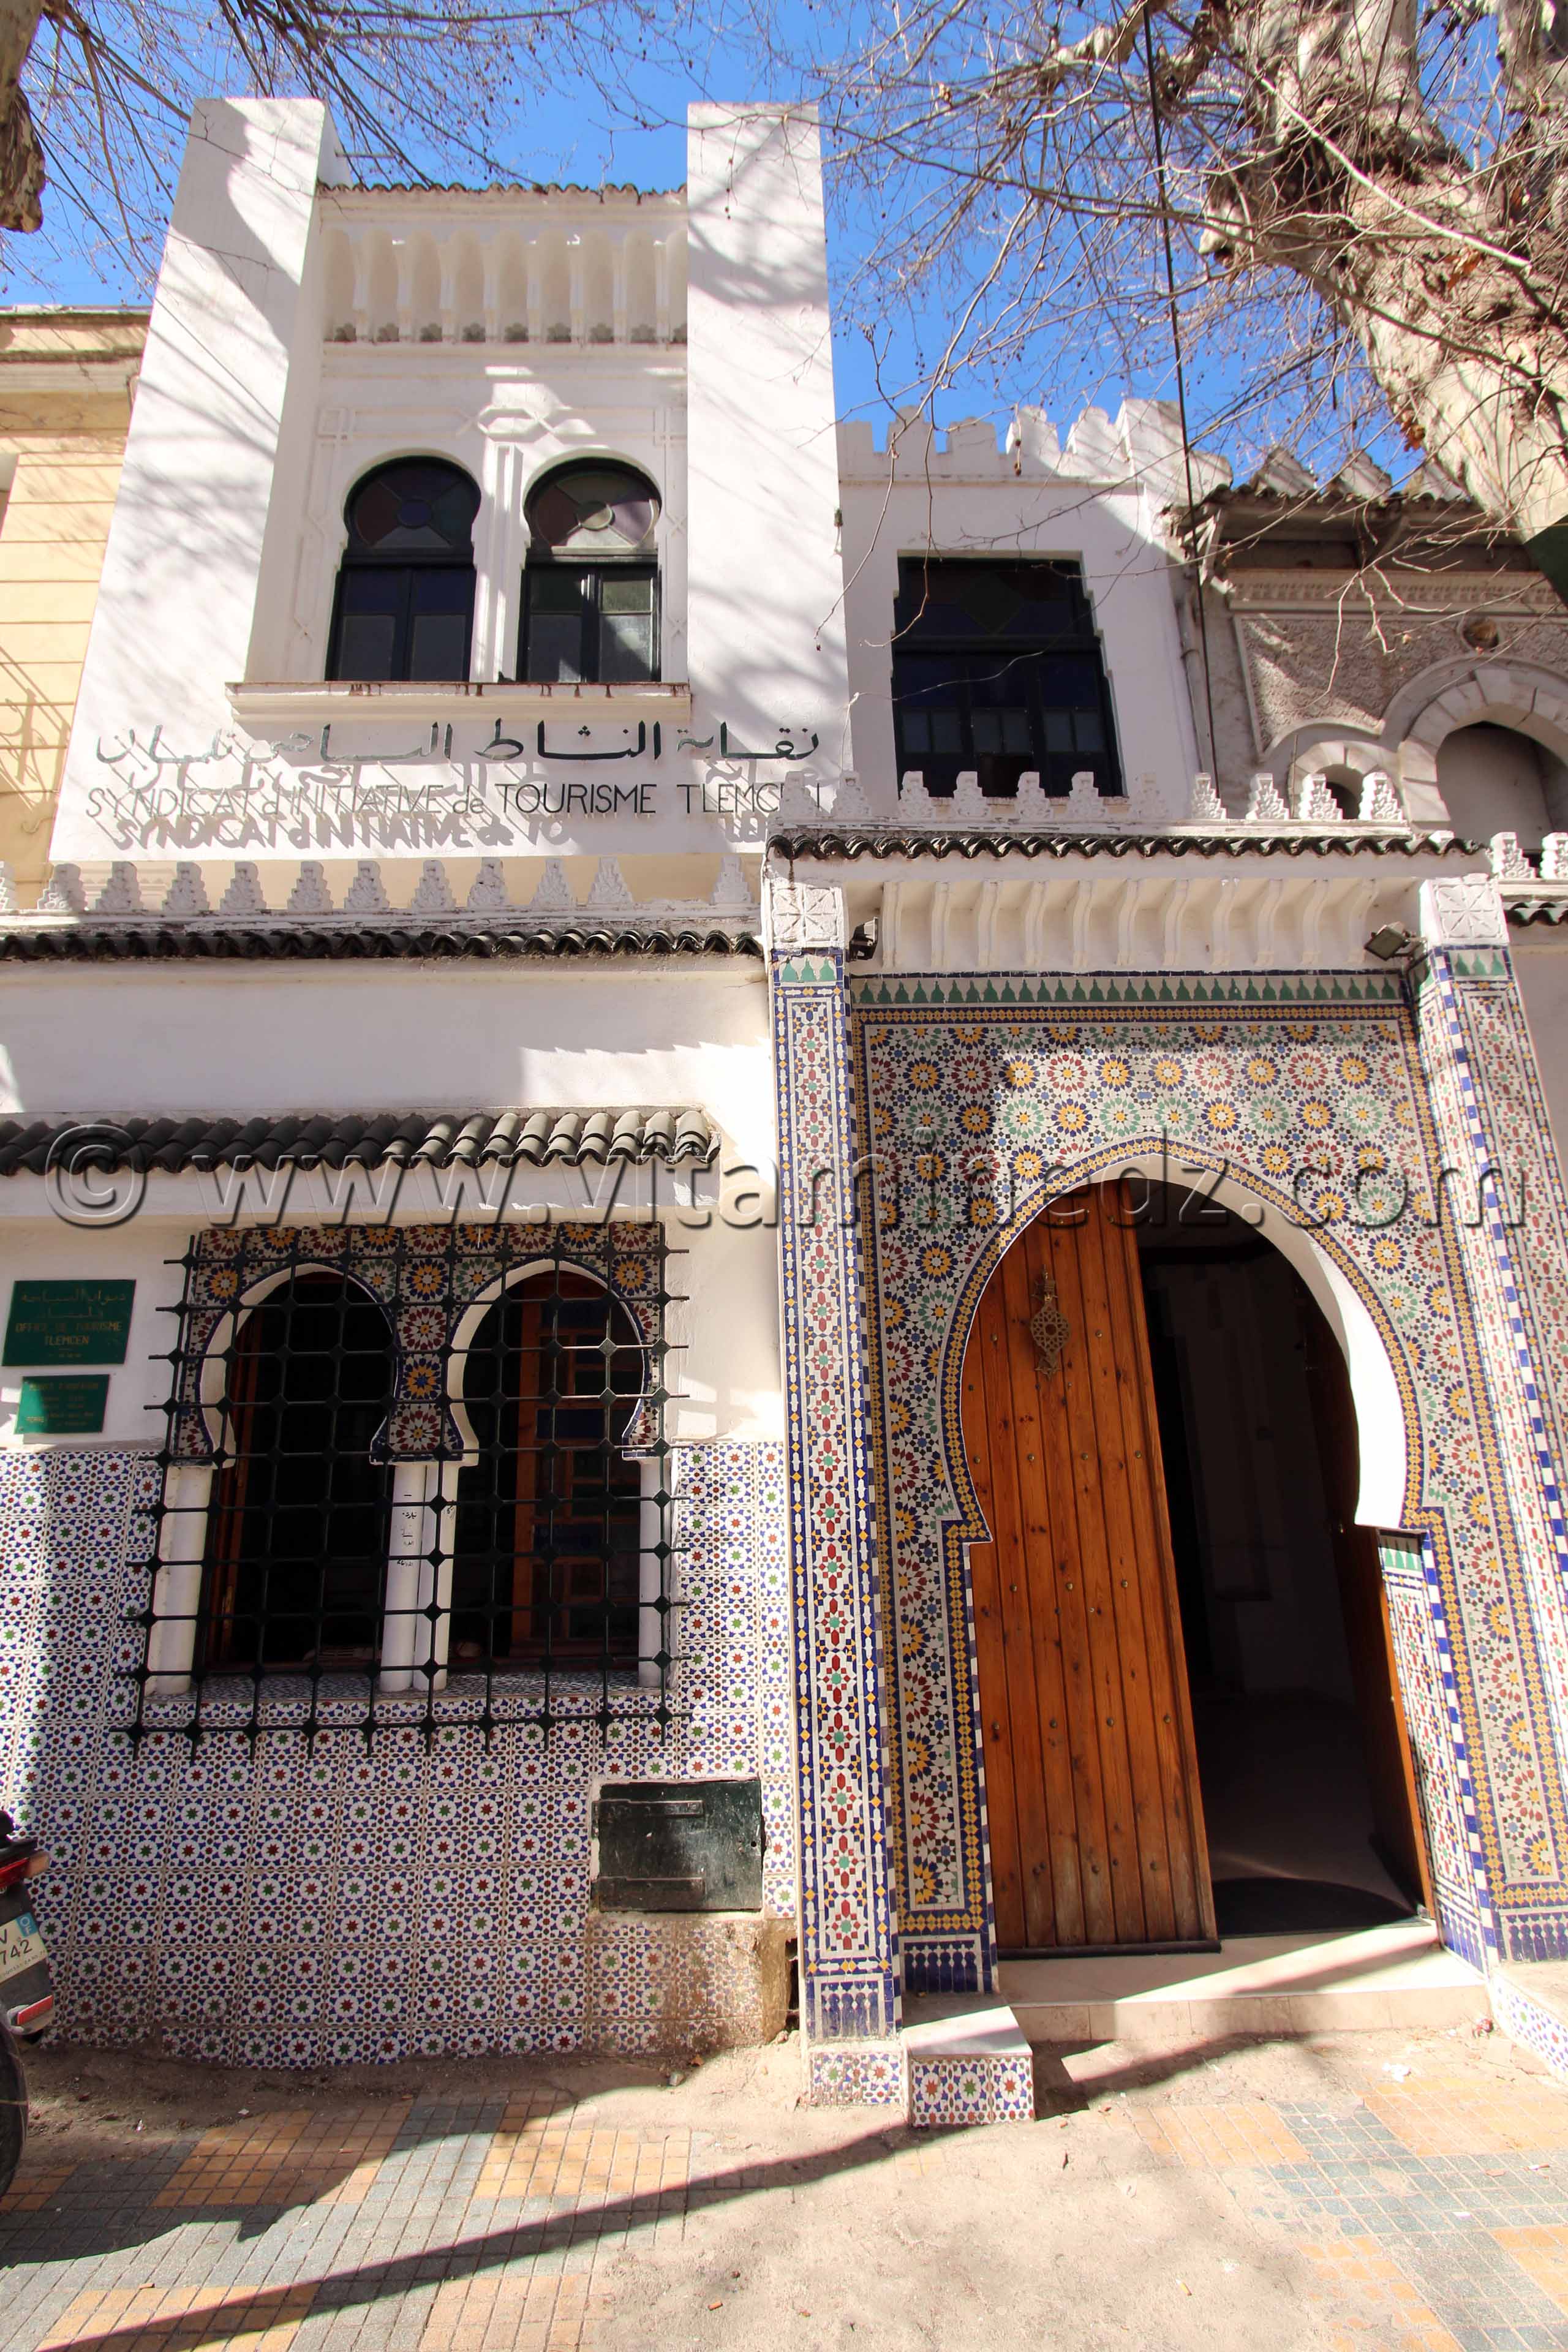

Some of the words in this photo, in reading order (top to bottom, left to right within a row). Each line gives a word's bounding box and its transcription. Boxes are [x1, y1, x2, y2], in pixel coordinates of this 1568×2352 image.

[473, 717, 661, 761] النشاط
[86, 786, 262, 818] SYNDICAT
[452, 784, 484, 815] de
[495, 783, 657, 814] TOURISME
